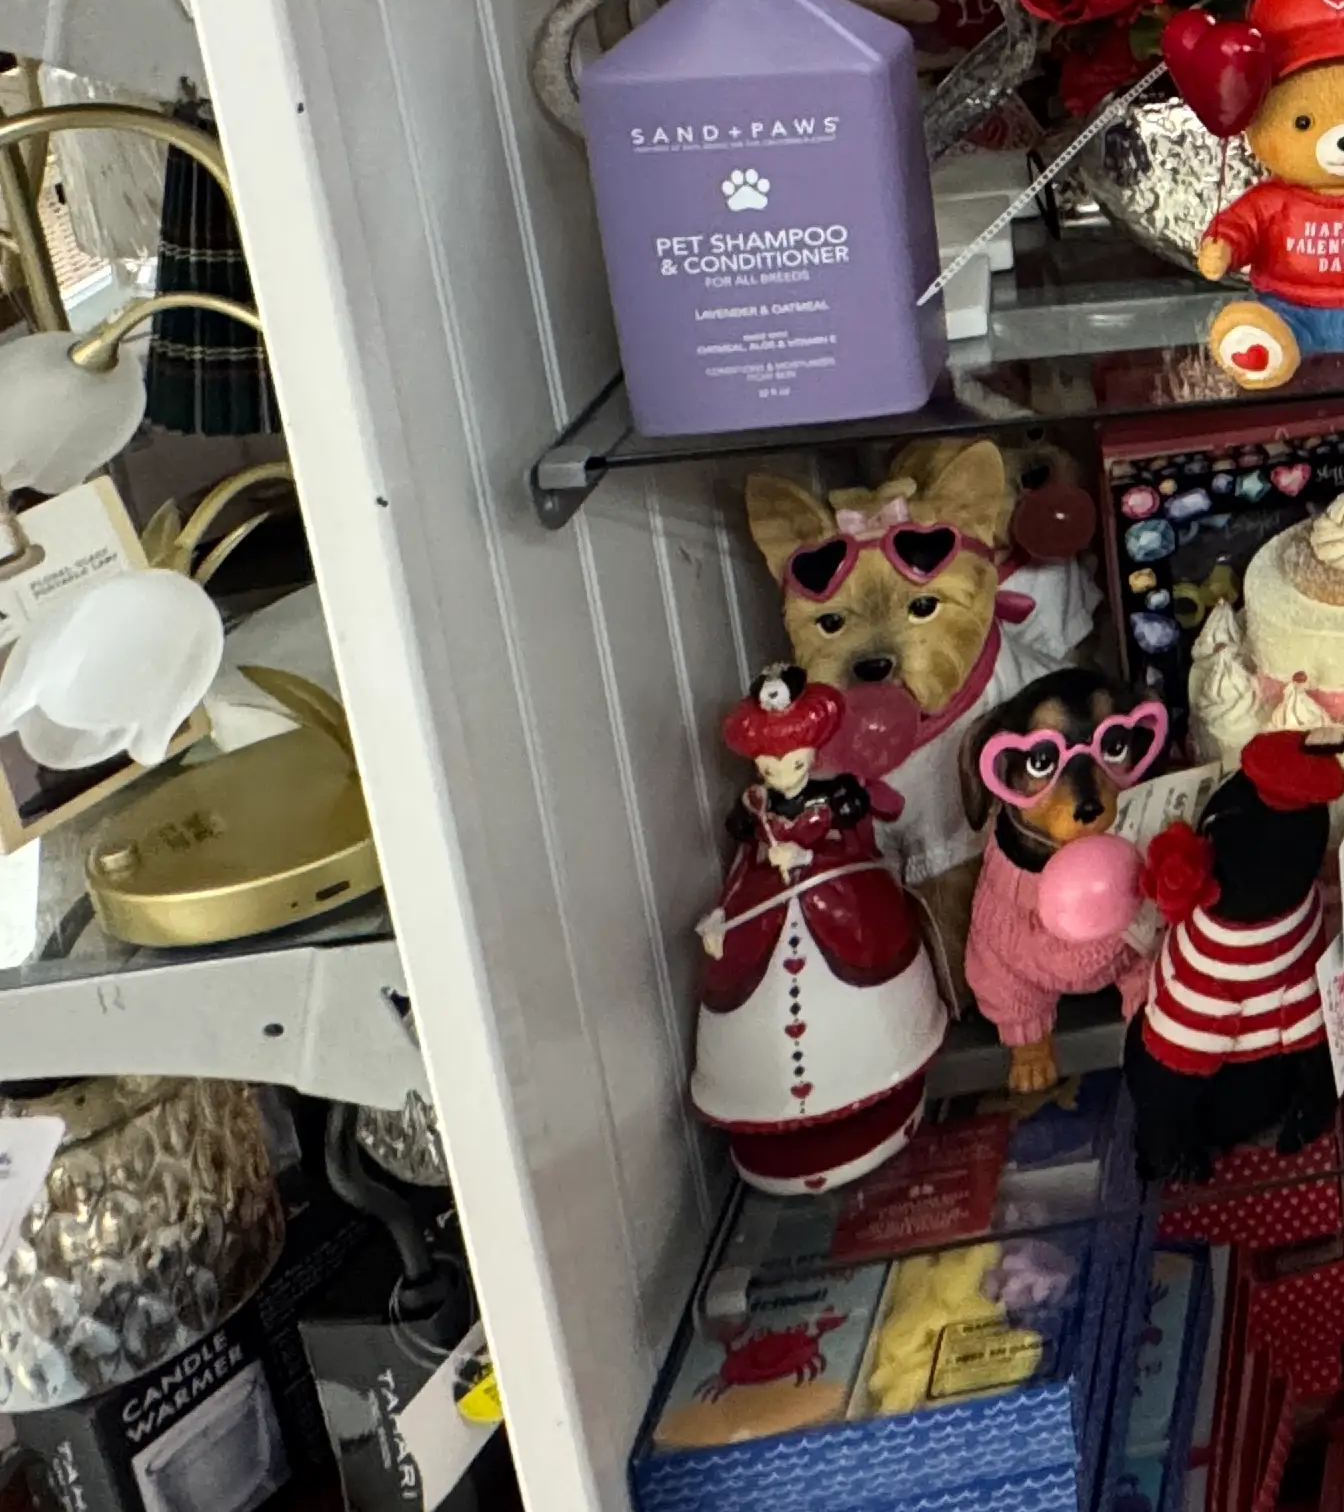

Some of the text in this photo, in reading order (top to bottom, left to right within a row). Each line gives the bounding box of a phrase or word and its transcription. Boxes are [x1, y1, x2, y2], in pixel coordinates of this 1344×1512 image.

[630, 124, 720, 146] SAND
[728, 126, 742, 138] +
[750, 116, 839, 139] PAWS
[656, 225, 849, 257] PET SHAMPOO
[659, 246, 850, 276] & CONDITIONER
[705, 270, 811, 288] FOR ALL BREEDS
[694, 305, 758, 321] LAVENDER
[771, 300, 831, 315] OATMEAL
[122, 1329, 227, 1423] CANDLE
[126, 1343, 245, 1443] WARMER
